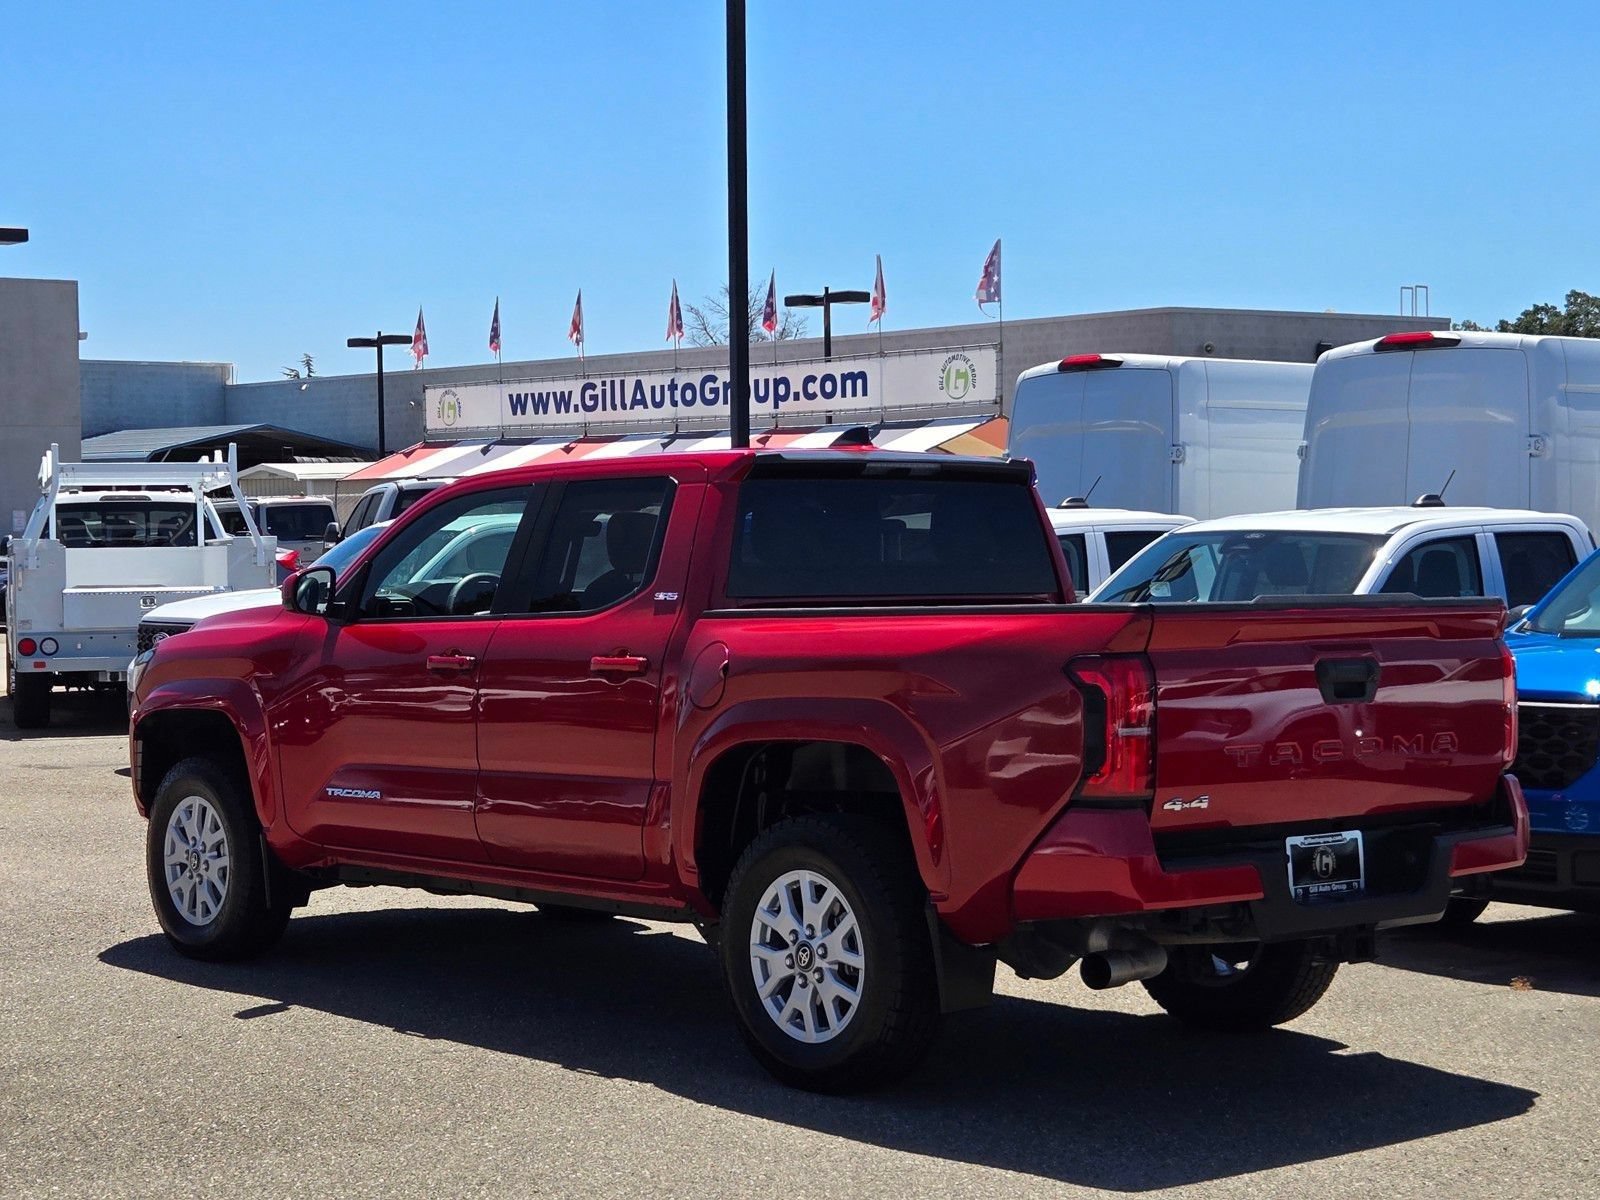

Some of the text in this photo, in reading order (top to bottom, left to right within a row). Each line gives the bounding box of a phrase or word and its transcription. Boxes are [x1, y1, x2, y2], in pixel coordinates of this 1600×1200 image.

[508, 370, 869, 416] www.GillAutoGrup.com
[1223, 732, 1459, 768] TACOMA
[325, 787, 381, 799] TACOMA
